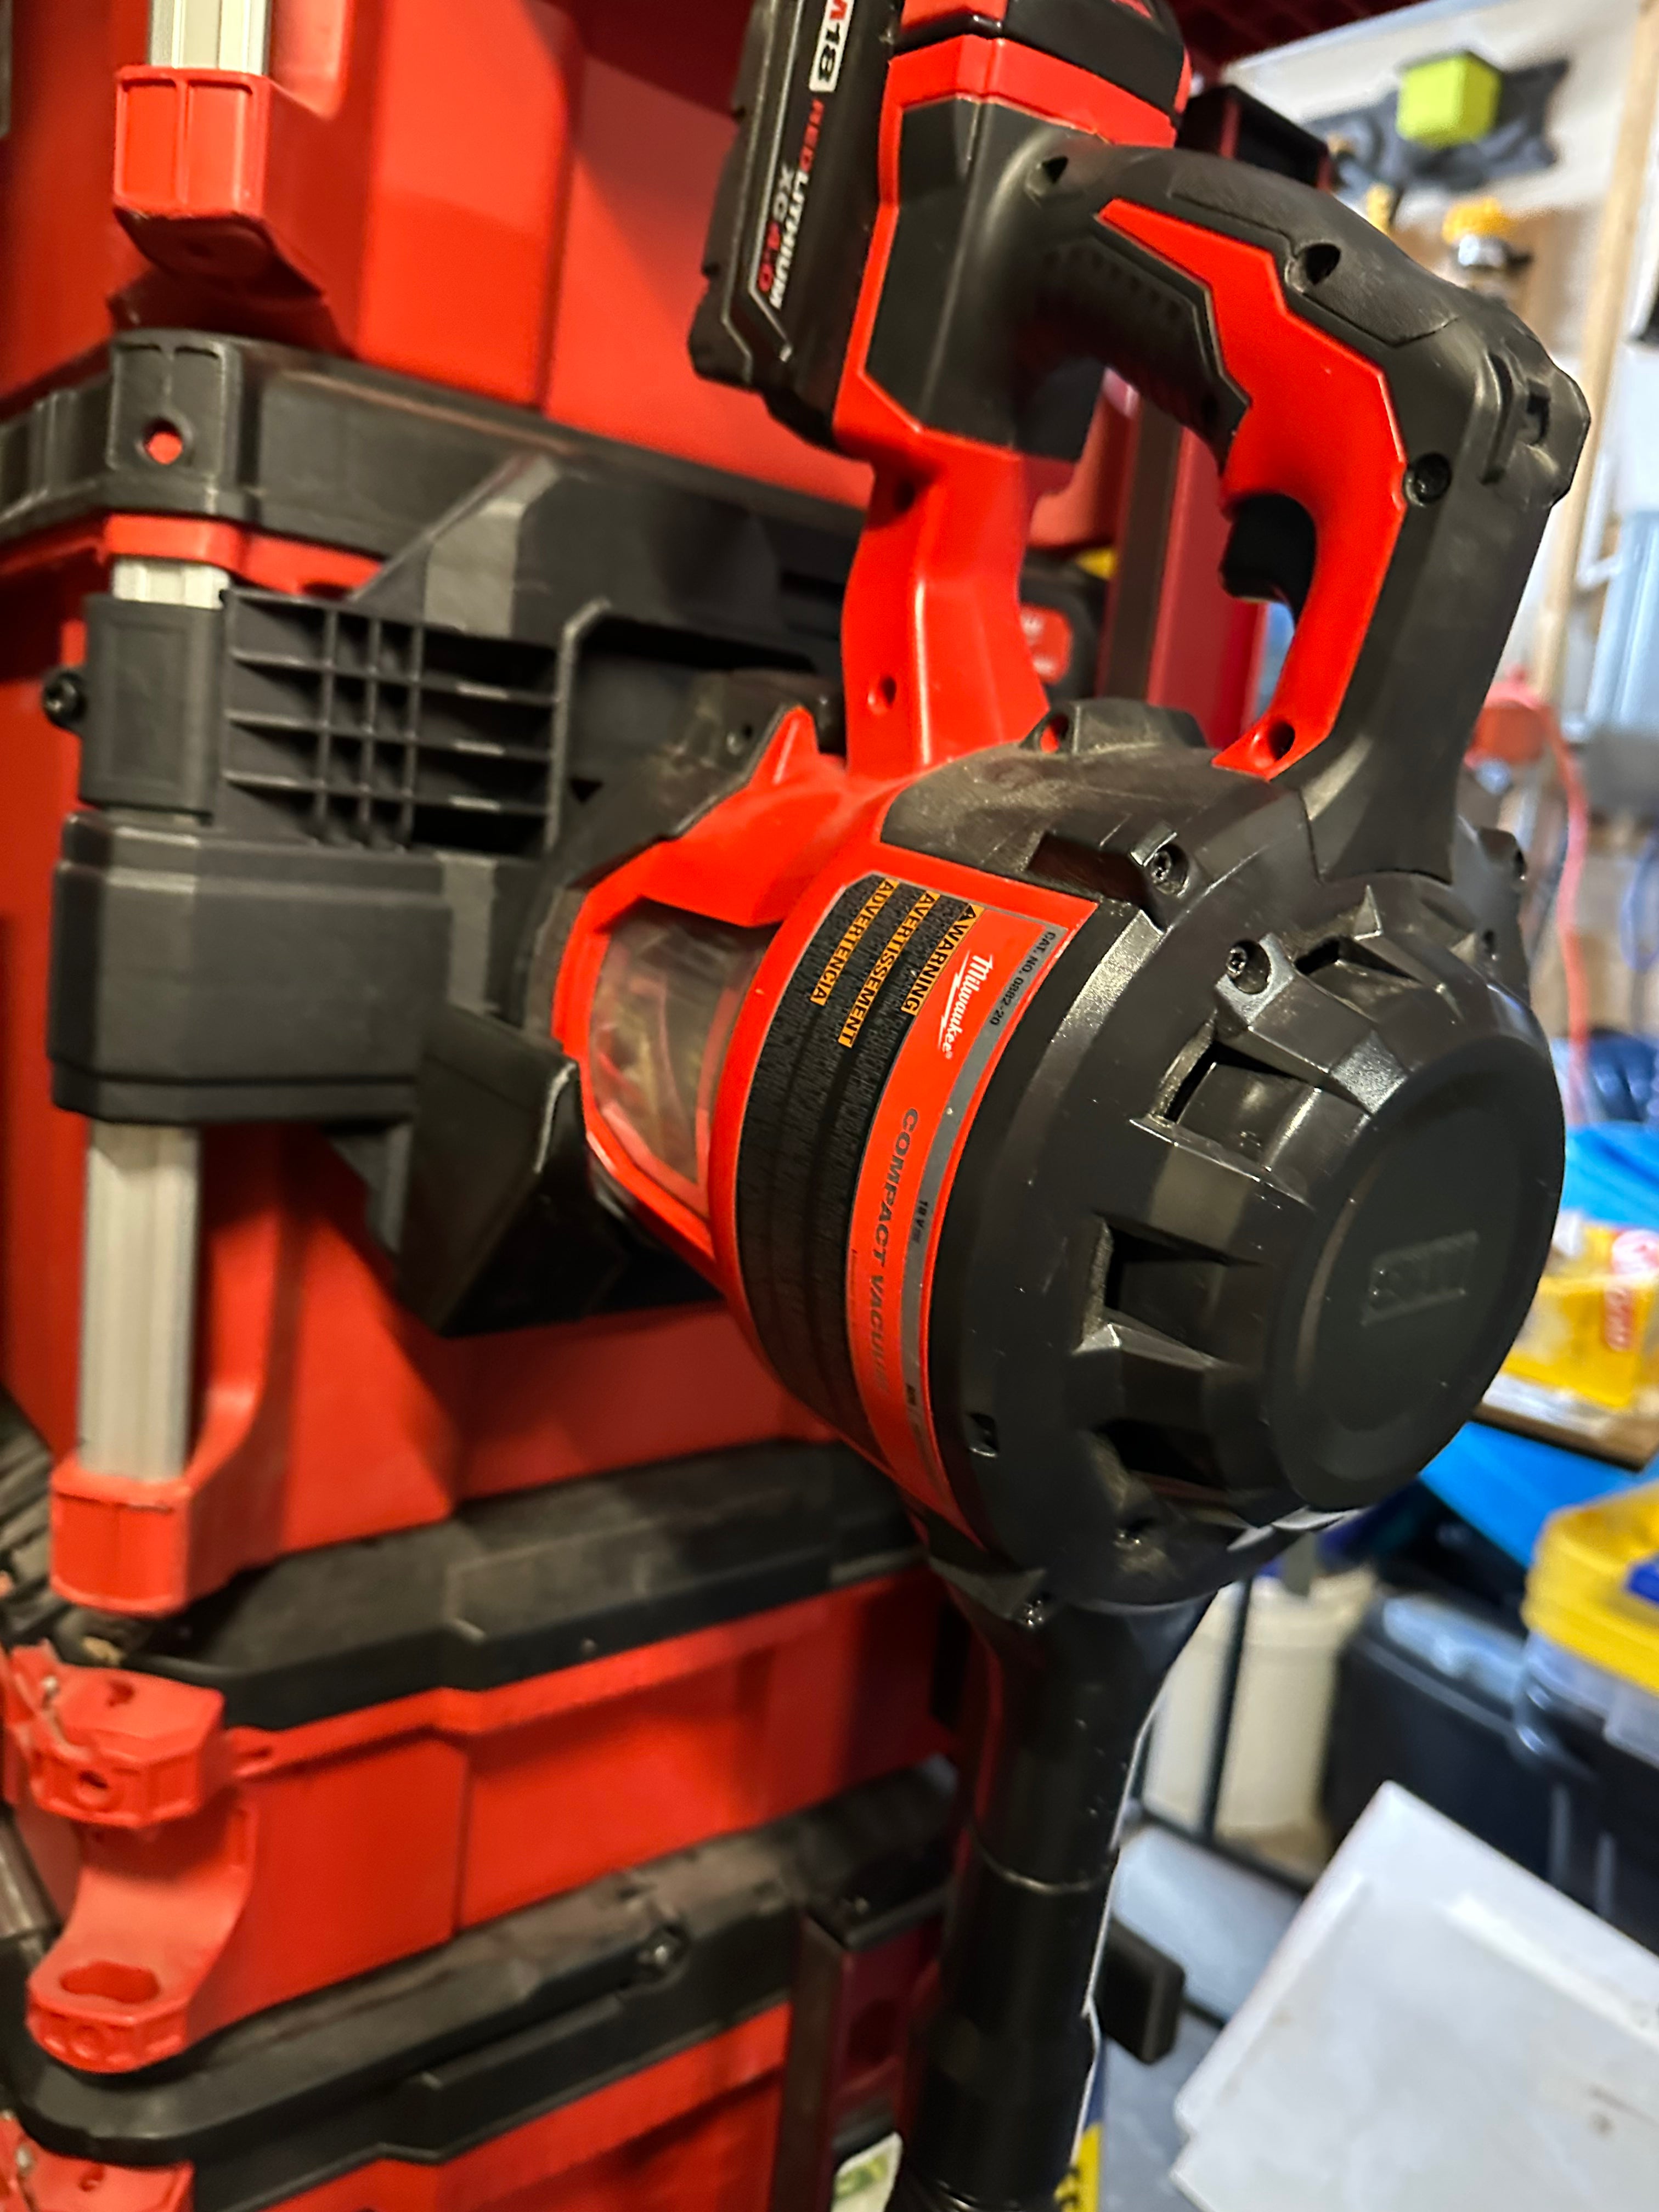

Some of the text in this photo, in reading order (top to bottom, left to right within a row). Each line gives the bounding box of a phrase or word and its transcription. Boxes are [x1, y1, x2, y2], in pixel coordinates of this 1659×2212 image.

[813, 879, 895, 1000] ADVERTENCIA
[841, 891, 935, 1045] AVERTISSEMENT
[905, 923, 969, 1012] WARNING
[1033, 932, 1056, 953] CAT.
[940, 953, 994, 1052] Milwaukee
[872, 1108, 918, 1268] COMPACT
